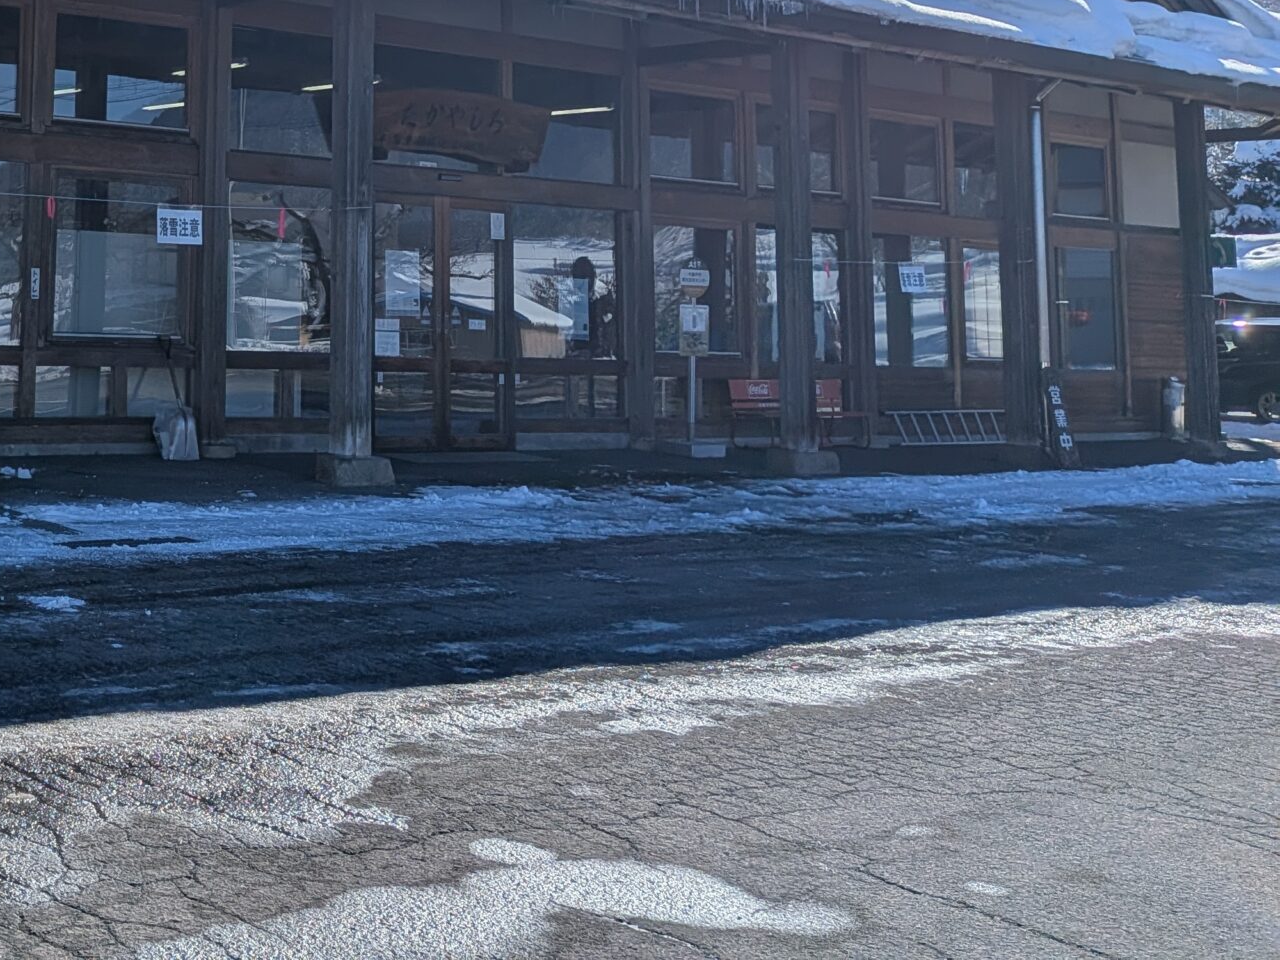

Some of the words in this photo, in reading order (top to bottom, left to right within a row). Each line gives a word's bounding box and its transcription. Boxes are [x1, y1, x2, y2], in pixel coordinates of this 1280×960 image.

[159, 216, 200, 238] 落雪注意
[31, 269, 39, 293] トイレ
[1047, 384, 1074, 451] 営業中
